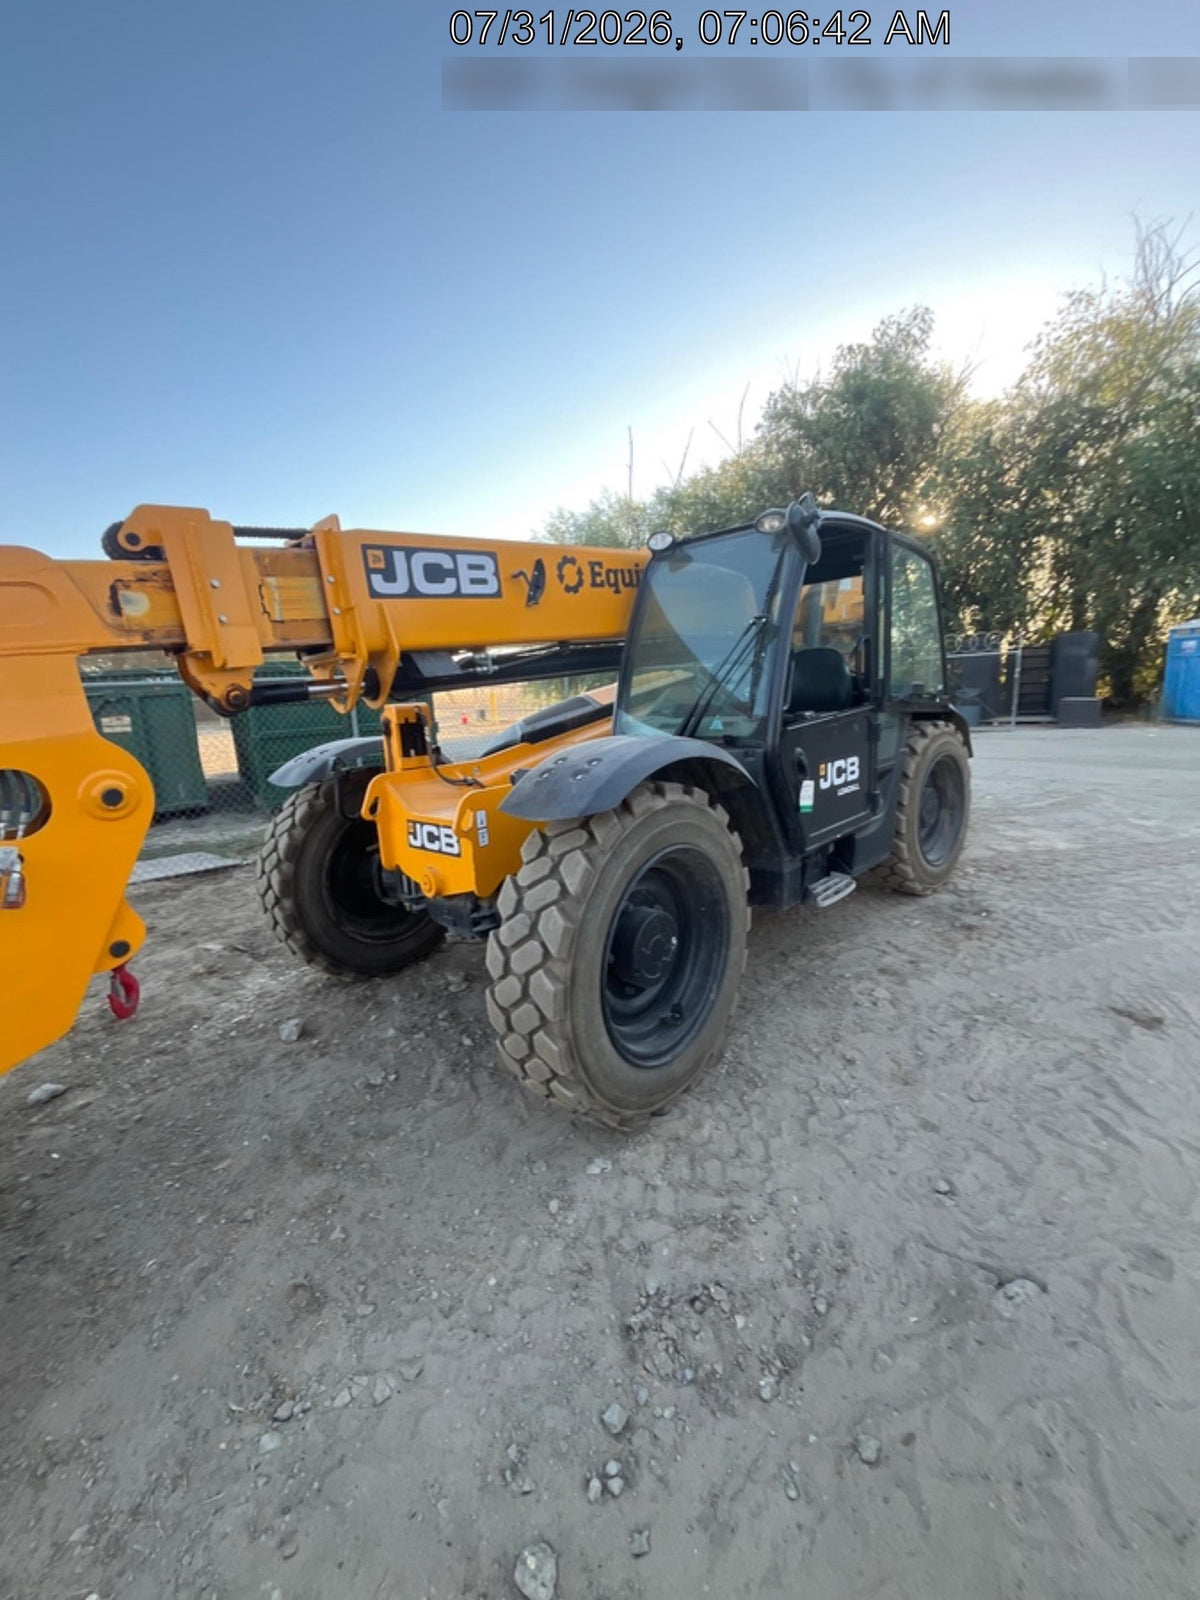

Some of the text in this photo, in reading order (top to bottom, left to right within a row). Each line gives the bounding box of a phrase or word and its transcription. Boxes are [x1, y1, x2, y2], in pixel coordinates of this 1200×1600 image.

[371, 551, 498, 595] JCB
[588, 561, 643, 594] Equi
[819, 756, 860, 790] JCB
[409, 822, 459, 854] JCB
